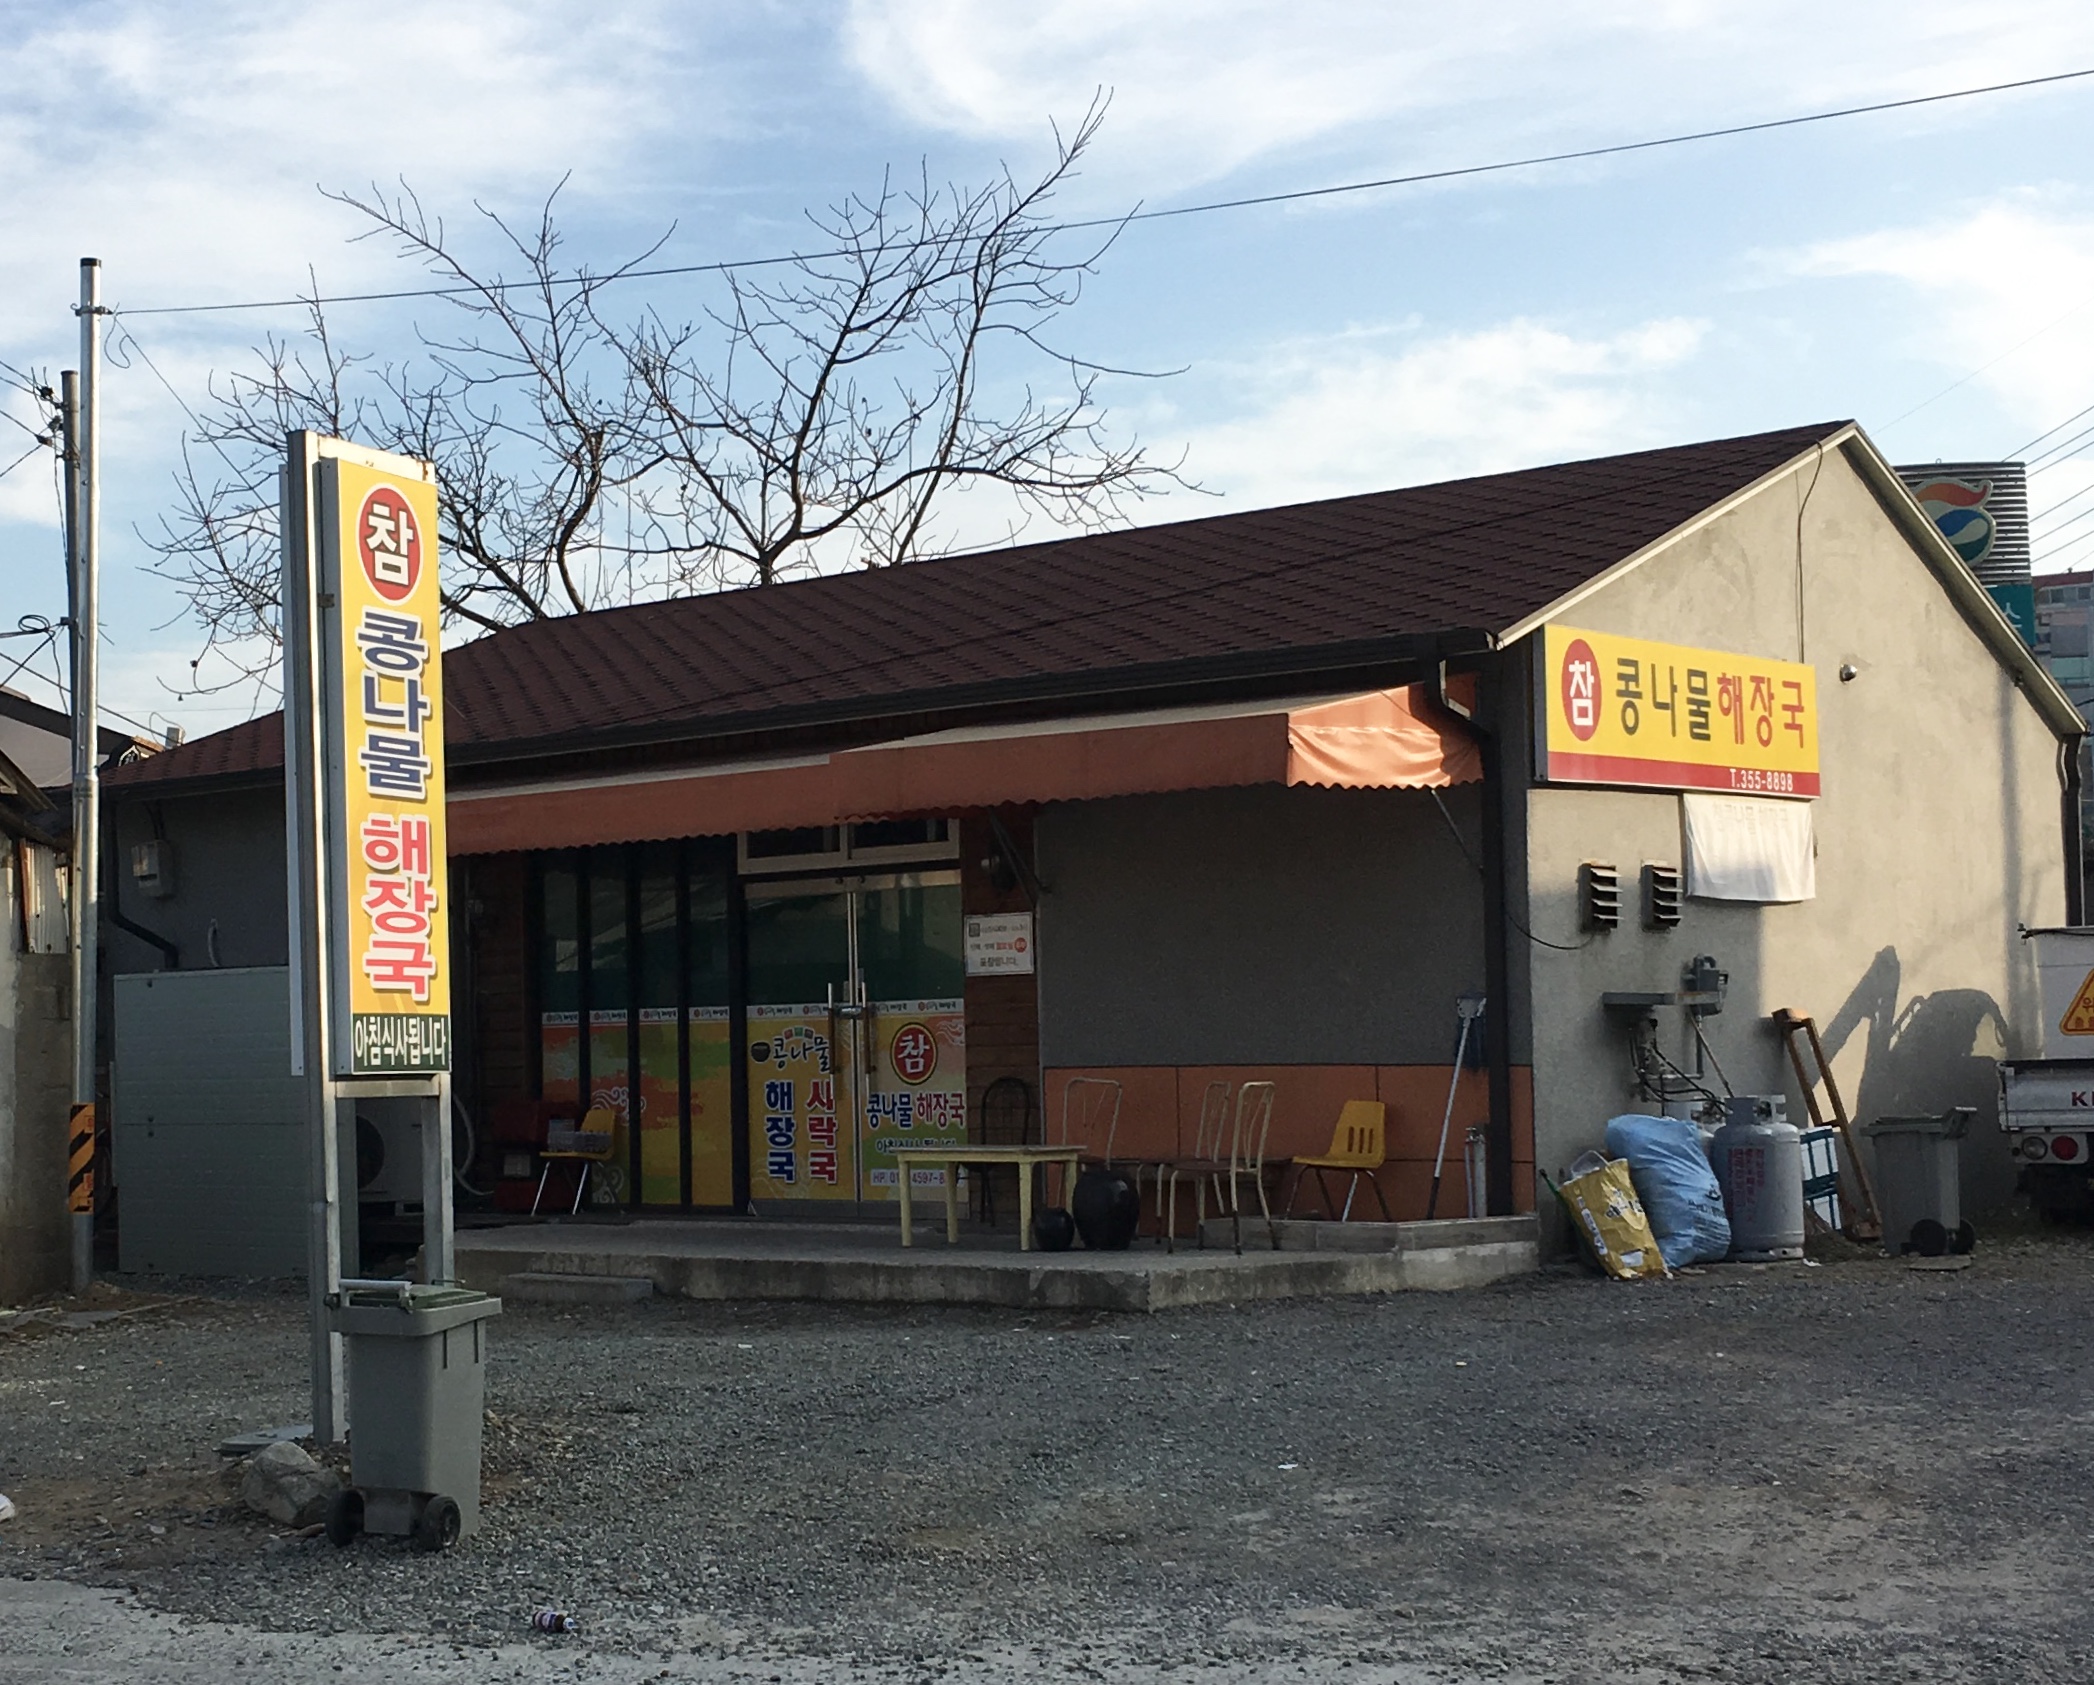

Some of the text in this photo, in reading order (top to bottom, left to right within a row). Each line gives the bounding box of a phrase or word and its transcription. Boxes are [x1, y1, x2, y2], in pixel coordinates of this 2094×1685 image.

[367, 502, 415, 588] 참
[1568, 659, 1595, 727] 참
[358, 610, 433, 997] 콩나물 해장국
[1729, 768, 1794, 792] T.355-8898
[772, 1036, 829, 1073] 콩나물
[898, 1033, 931, 1073] 참
[765, 1081, 795, 1181] 해장국
[866, 1092, 965, 1128] 콩나물 해장국
